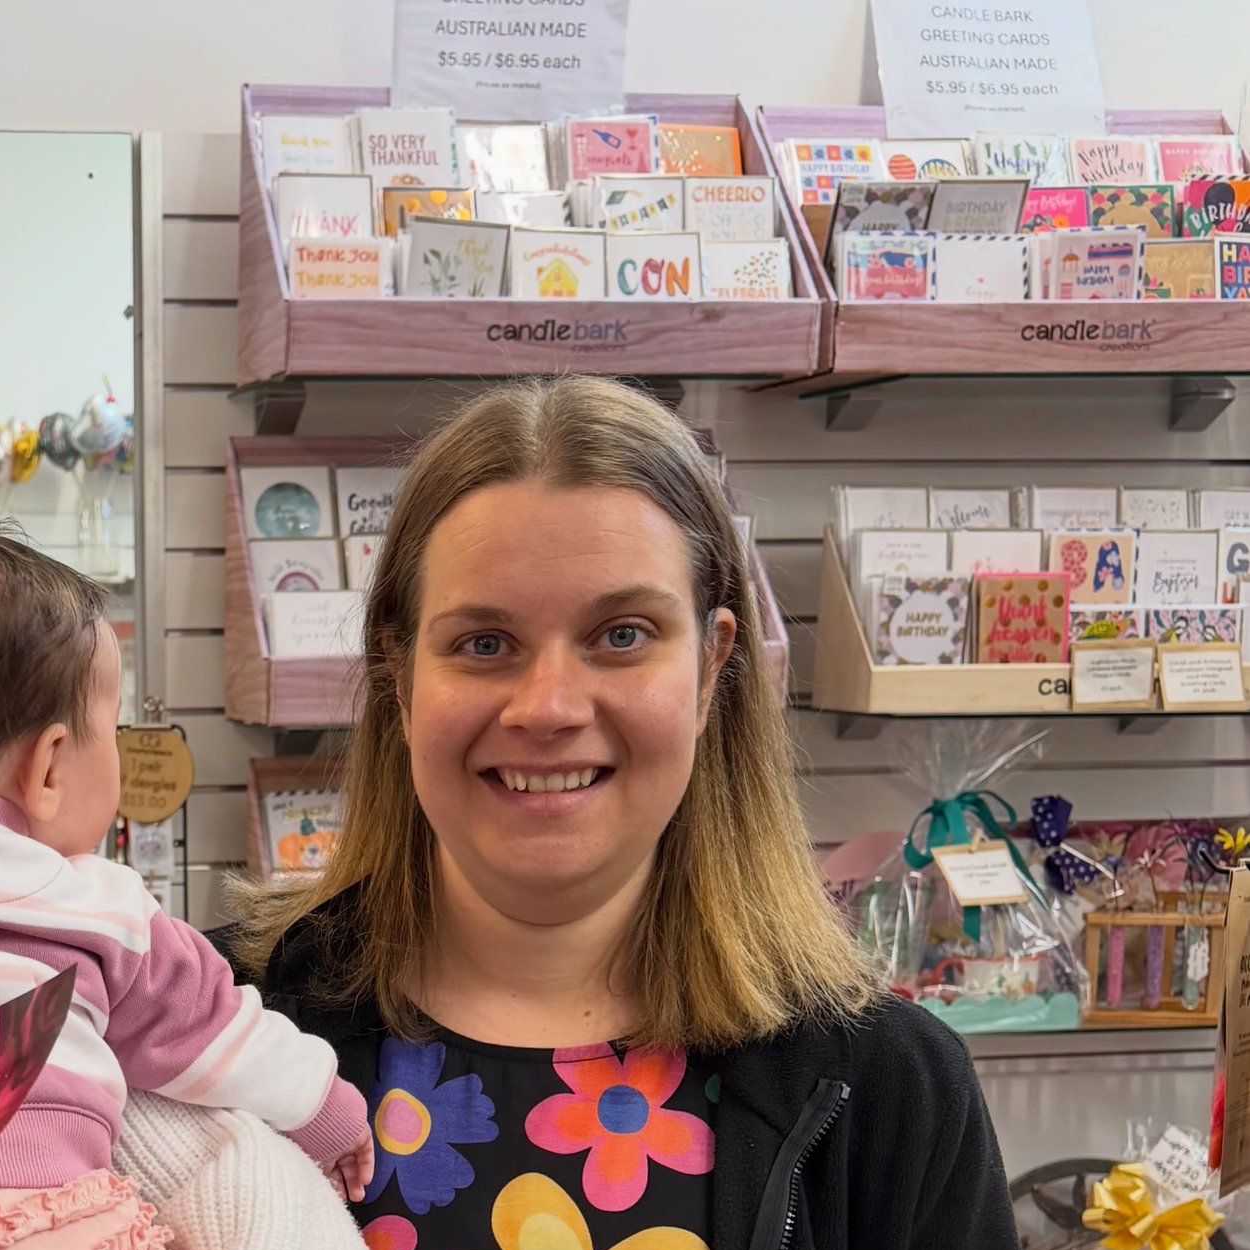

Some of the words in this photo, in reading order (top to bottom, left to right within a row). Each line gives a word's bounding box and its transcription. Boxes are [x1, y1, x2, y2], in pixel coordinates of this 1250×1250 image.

[931, 5, 991, 22] CANDLE
[994, 10, 1033, 23] BARK
[434, 19, 536, 38] AUSTRALIAN
[539, 22, 588, 39] MADE
[920, 28, 995, 45] GREETING
[998, 32, 1051, 46] CARDS
[437, 51, 482, 68] $5.95
[494, 52, 540, 69] $6.95
[542, 54, 582, 70] each
[919, 54, 1010, 70] AUSTRALIAN
[1014, 57, 1058, 71] MADE
[925, 80, 967, 95] $5.95
[979, 82, 1019, 96] $6.95
[1022, 82, 1059, 96] each
[368, 134, 387, 150] SO
[391, 134, 426, 150] VERY
[370, 150, 440, 166] THANKFUL
[799, 163, 828, 174] HAPPY
[829, 163, 871, 175] BIRTHDAY
[691, 184, 767, 203] CHEERIO
[943, 201, 1007, 214] BIRTHDAY
[296, 247, 347, 265] Thank
[295, 271, 346, 288] Thank
[616, 255, 691, 298] CON
[486, 319, 571, 342] candle
[573, 319, 627, 341] bark
[1020, 319, 1100, 342] candle
[1101, 319, 1152, 341] bark
[906, 612, 943, 624] HAPPY
[896, 626, 949, 638] BIRTHDAY
